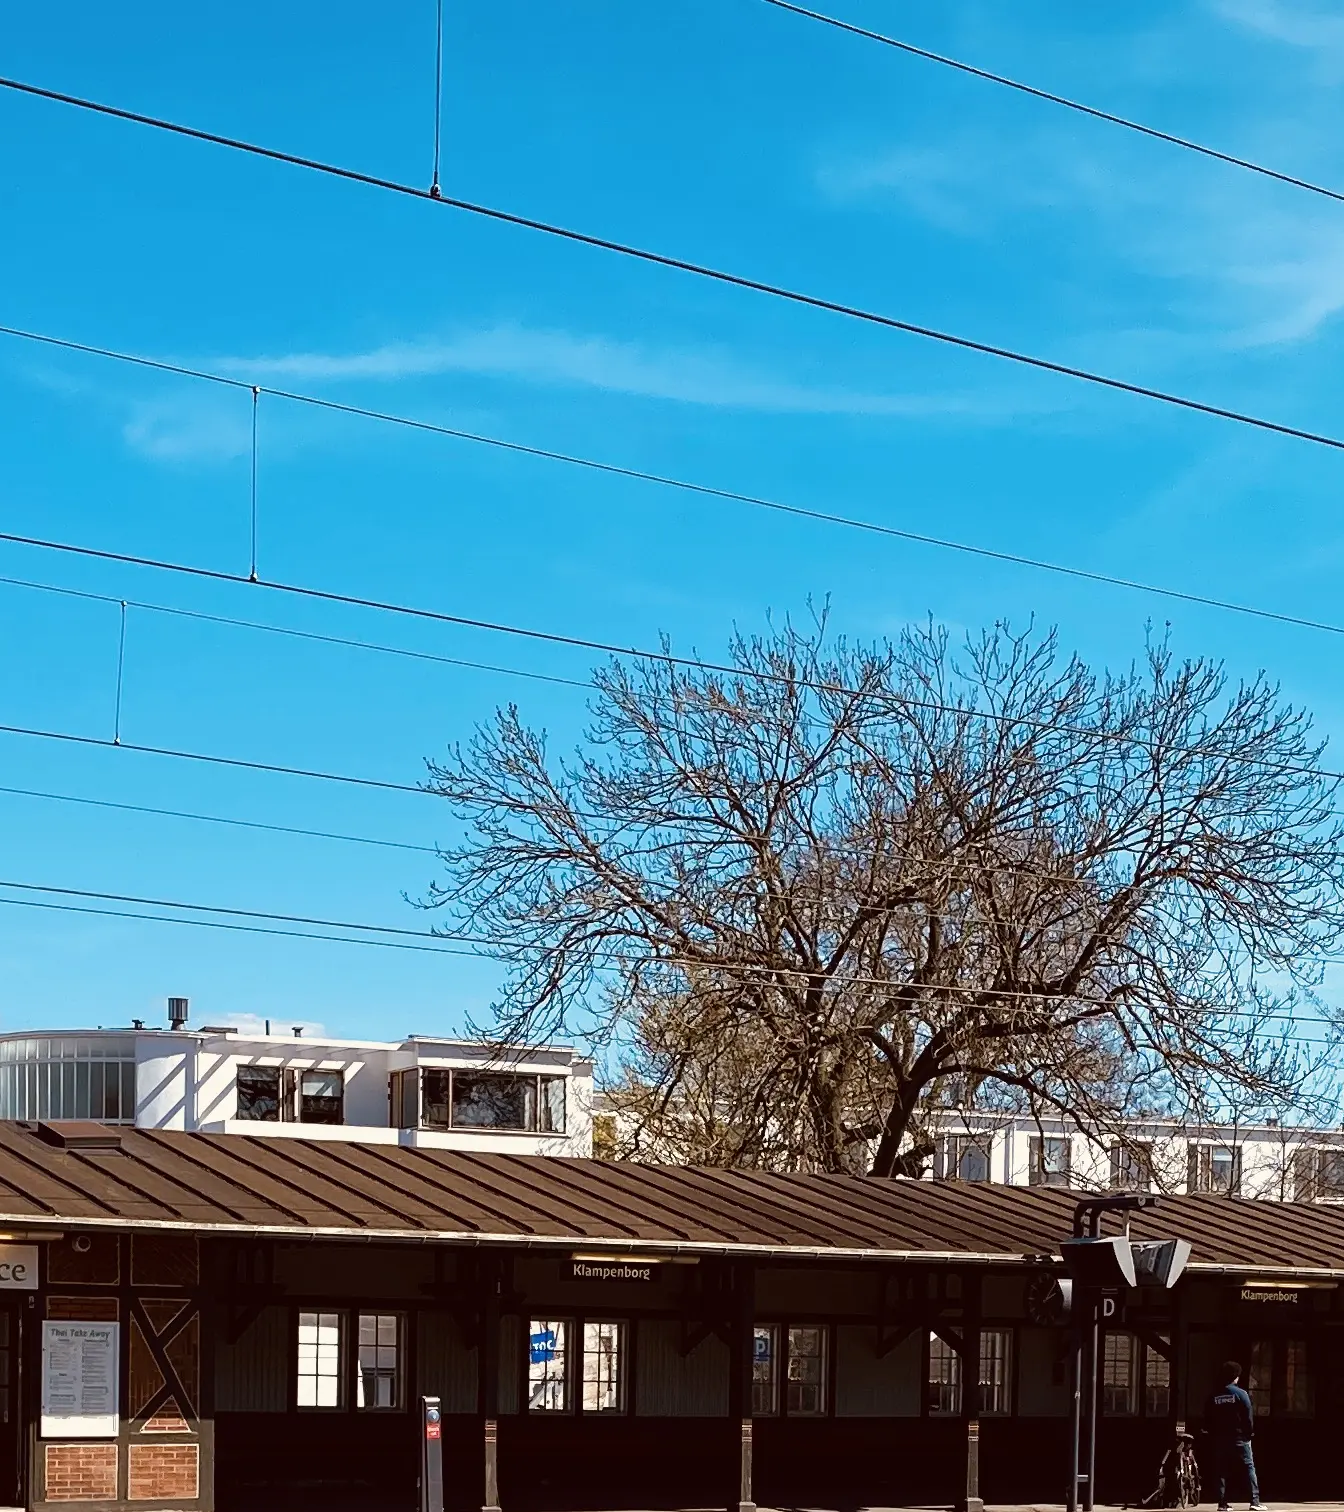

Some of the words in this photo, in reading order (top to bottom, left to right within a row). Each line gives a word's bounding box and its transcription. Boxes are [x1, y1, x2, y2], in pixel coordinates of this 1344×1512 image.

[573, 1263, 650, 1280] Klampenborg
[1241, 1289, 1298, 1303] Klampenborg
[1103, 1298, 1115, 1317] D
[51, 1328, 68, 1336] Thai
[70, 1329, 87, 1337] Take
[89, 1330, 111, 1340] Away
